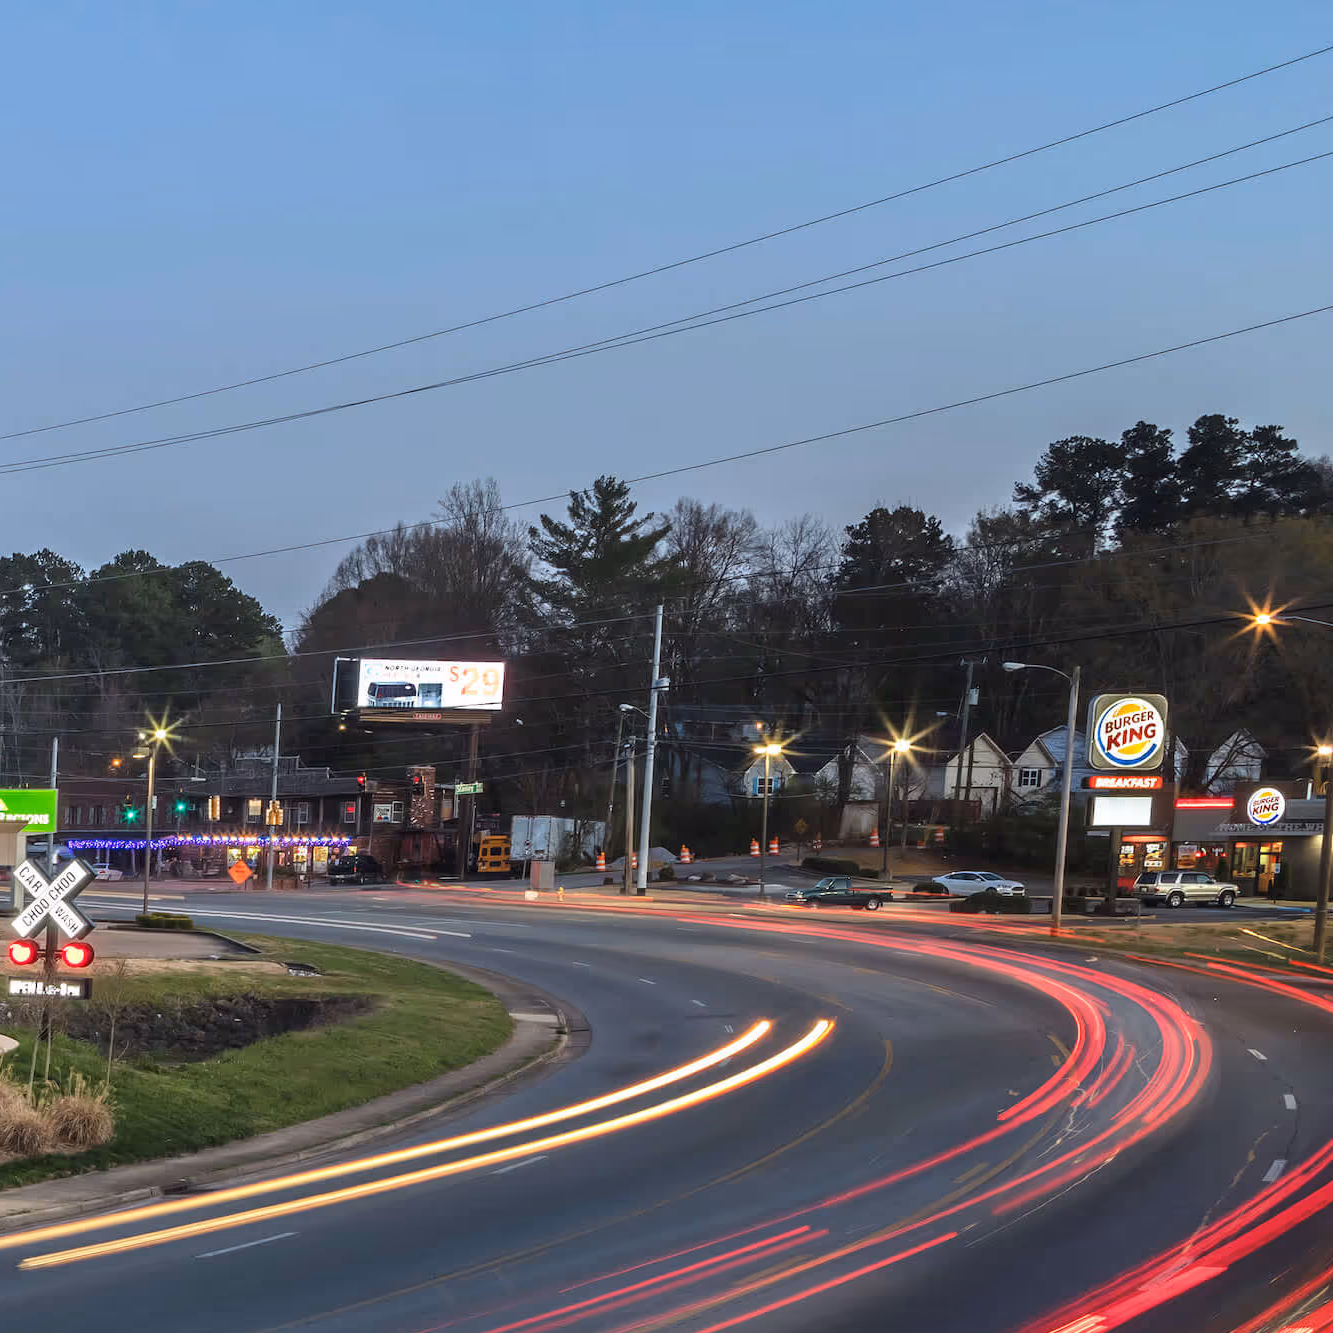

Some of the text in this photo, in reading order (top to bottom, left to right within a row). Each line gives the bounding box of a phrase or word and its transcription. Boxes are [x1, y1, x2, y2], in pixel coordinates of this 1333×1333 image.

[1105, 711, 1154, 734] BURGER
[1106, 723, 1156, 751] KING
[1094, 777, 1158, 789] BREAKFAST
[1252, 802, 1280, 815] KING
[1253, 796, 1280, 806] BURGER
[19, 866, 79, 933] CAR WASH
[22, 871, 77, 927] CHOO CHOO
